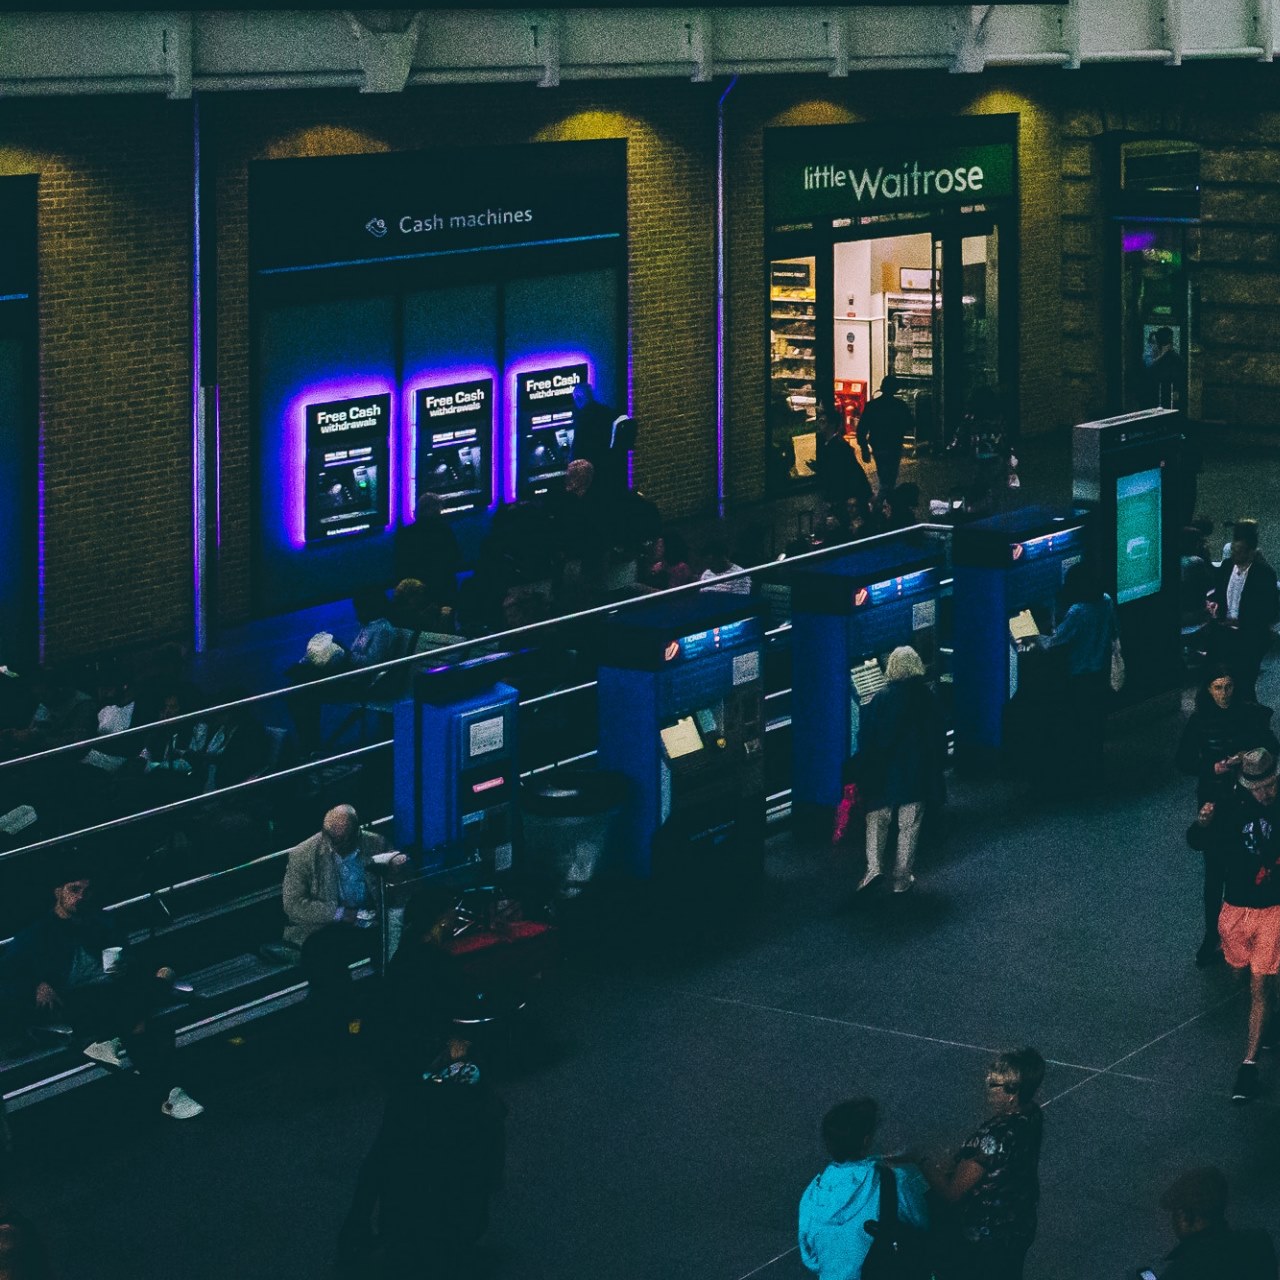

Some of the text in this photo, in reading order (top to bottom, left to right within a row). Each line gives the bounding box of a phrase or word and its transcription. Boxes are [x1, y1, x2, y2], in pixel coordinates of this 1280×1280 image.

[804, 160, 984, 201] little Waitrose
[399, 208, 533, 233] Cash machines
[526, 373, 581, 392] Free Cash
[426, 389, 485, 410] Free Cash
[429, 401, 481, 418] withdrawals
[317, 404, 381, 425] Free Cash
[320, 417, 377, 434] withdrawals
